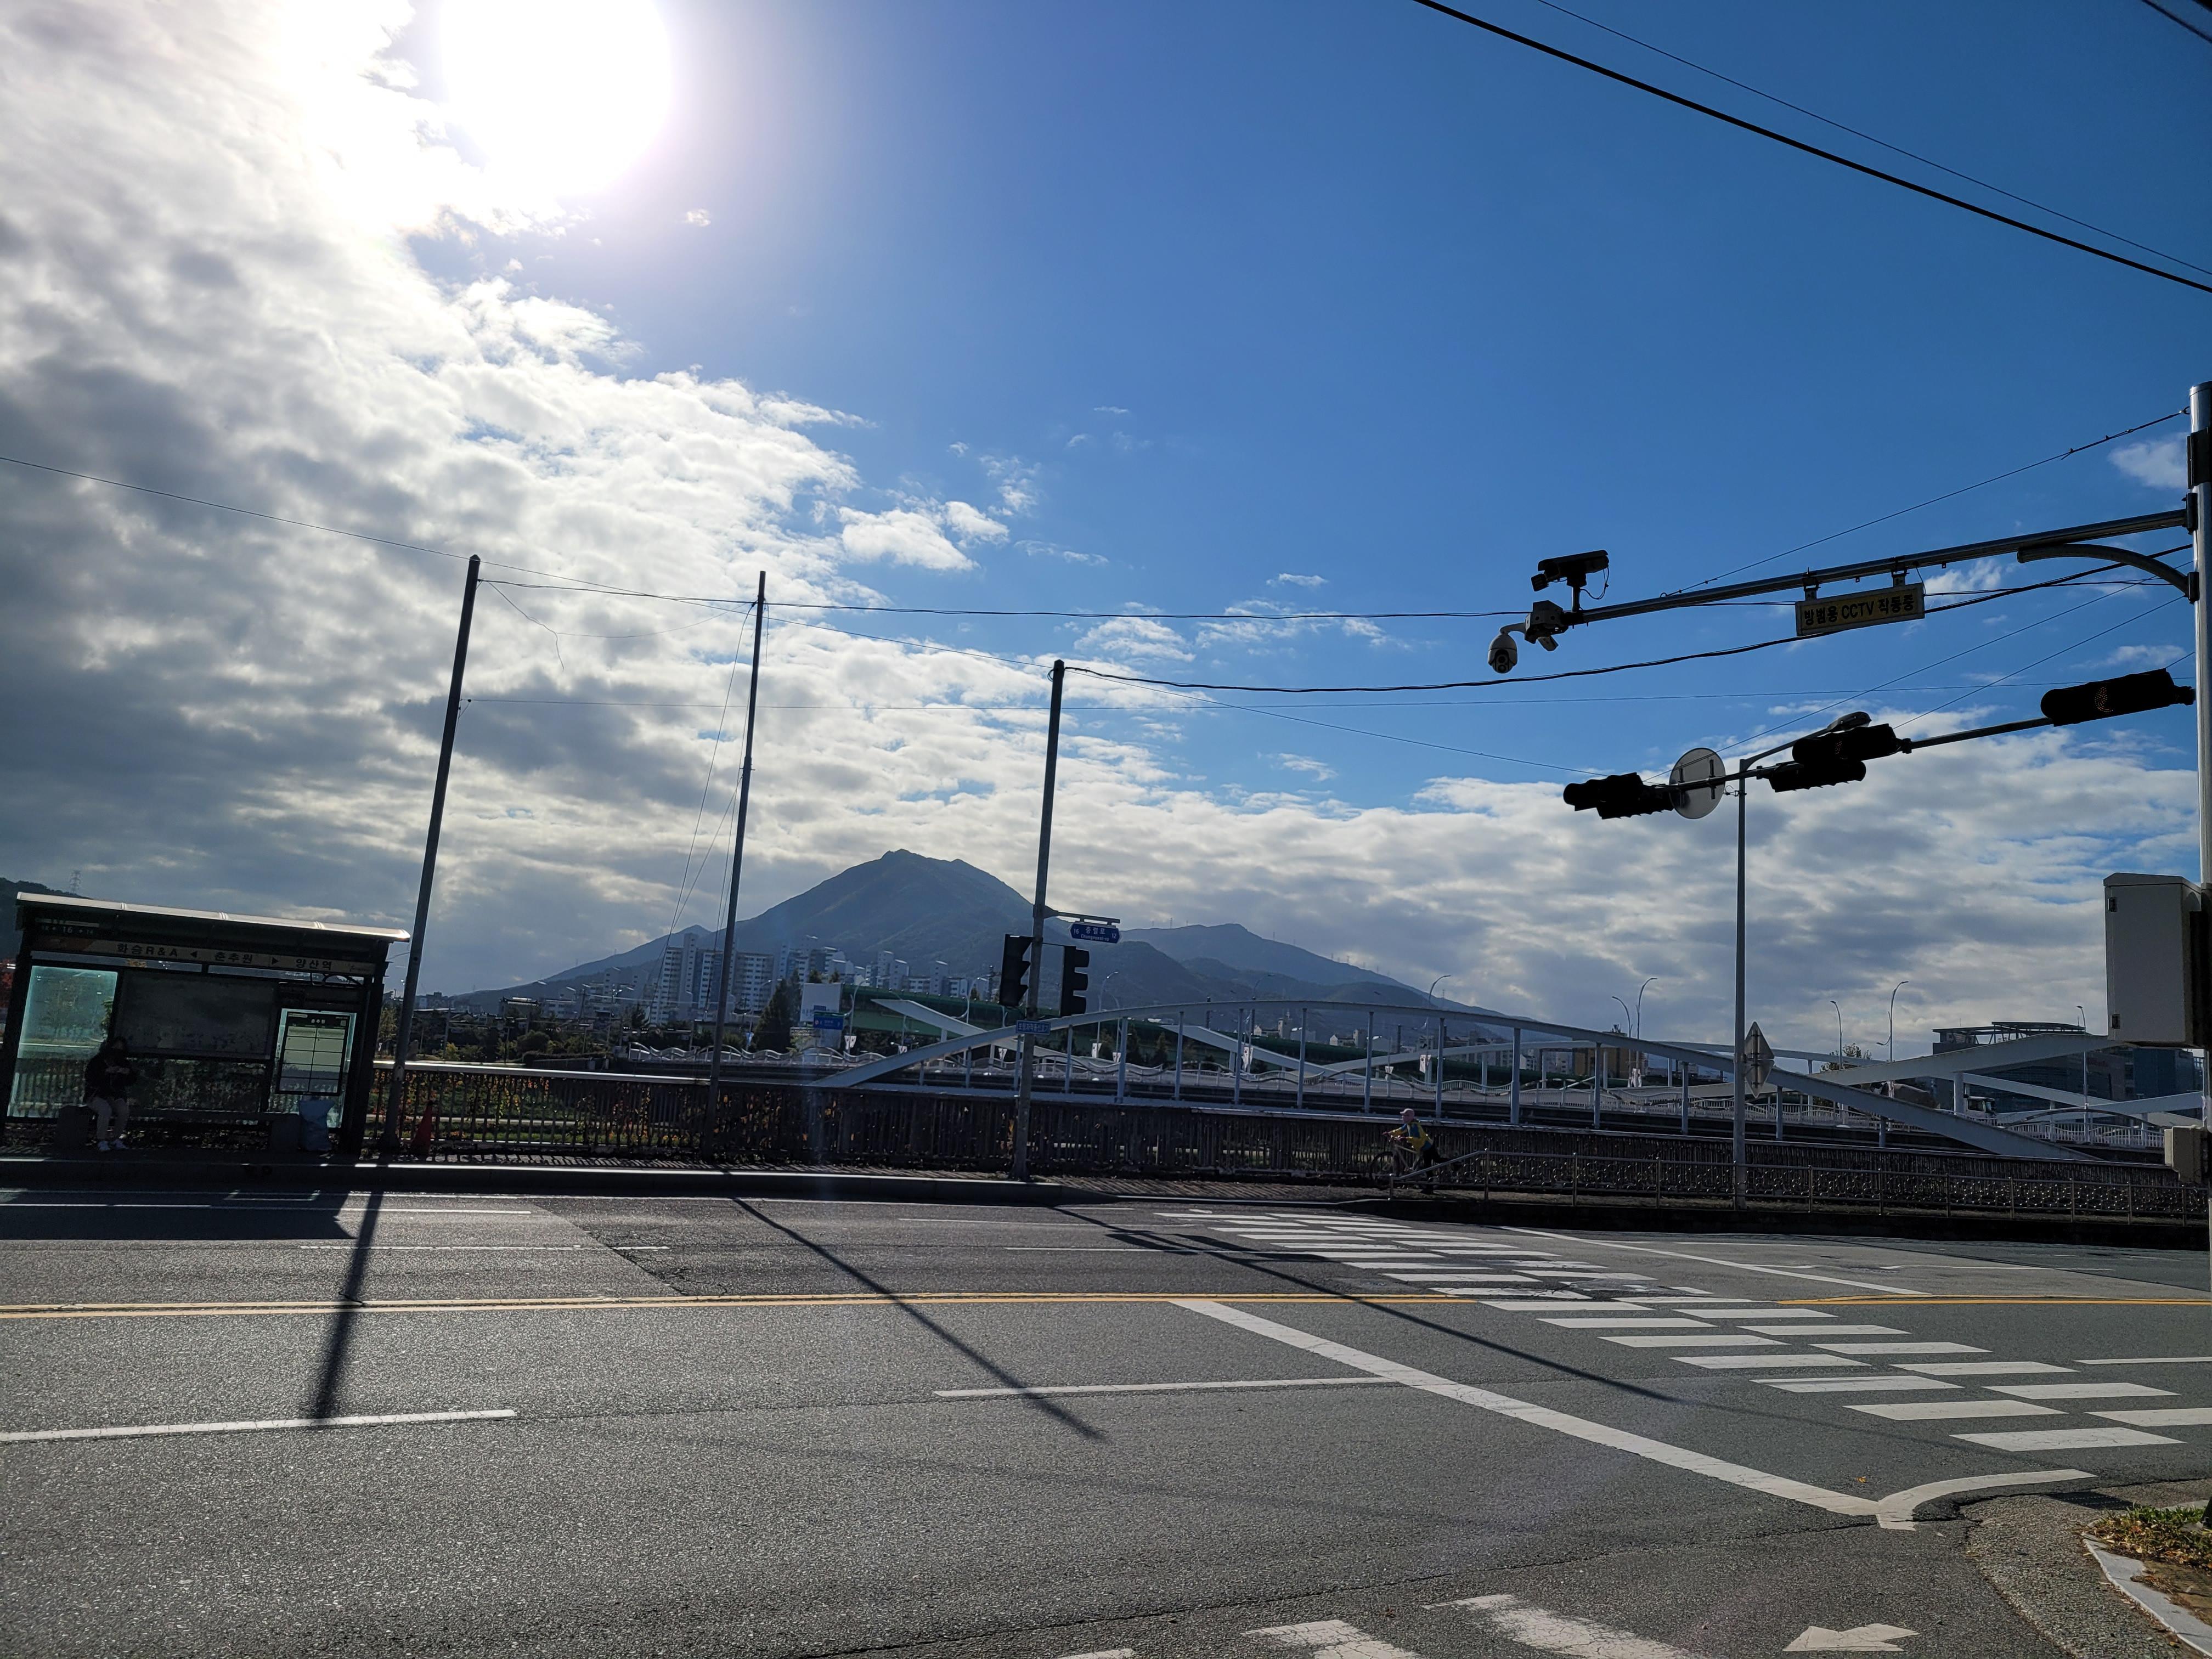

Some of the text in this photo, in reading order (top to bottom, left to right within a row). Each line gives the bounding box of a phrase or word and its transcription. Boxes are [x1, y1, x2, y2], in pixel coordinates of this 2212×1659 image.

[1804, 594, 1914, 625] 방범용 CCTV 작동중
[1085, 926, 1106, 935] 충렬로
[117, 943, 332, 970] 화승R&A 춘추원 양산역
